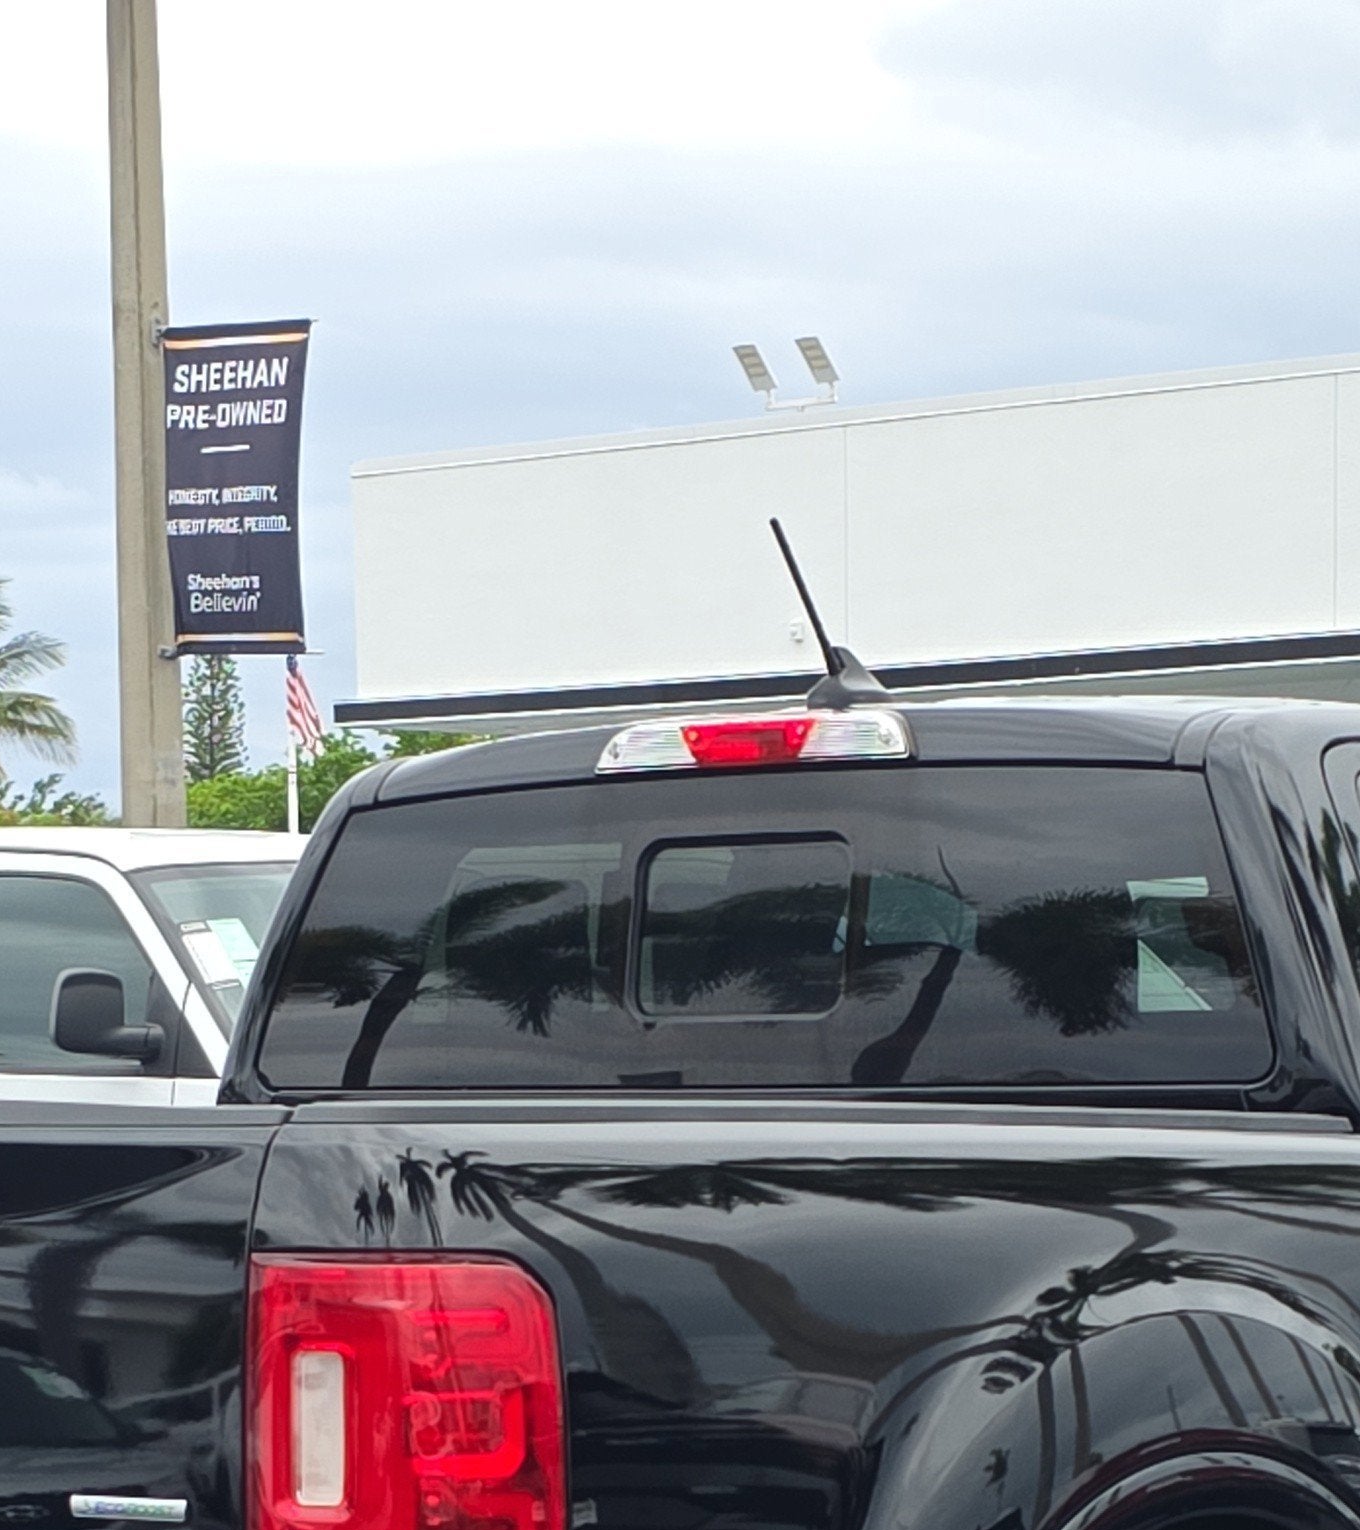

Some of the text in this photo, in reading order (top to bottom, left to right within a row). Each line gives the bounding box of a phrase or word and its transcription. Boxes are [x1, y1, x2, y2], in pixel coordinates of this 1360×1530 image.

[173, 357, 289, 393] SHEEHAN
[166, 399, 287, 430] PRE-OWNED
[187, 573, 261, 590] Sheehan's
[190, 591, 261, 613] Believin'
